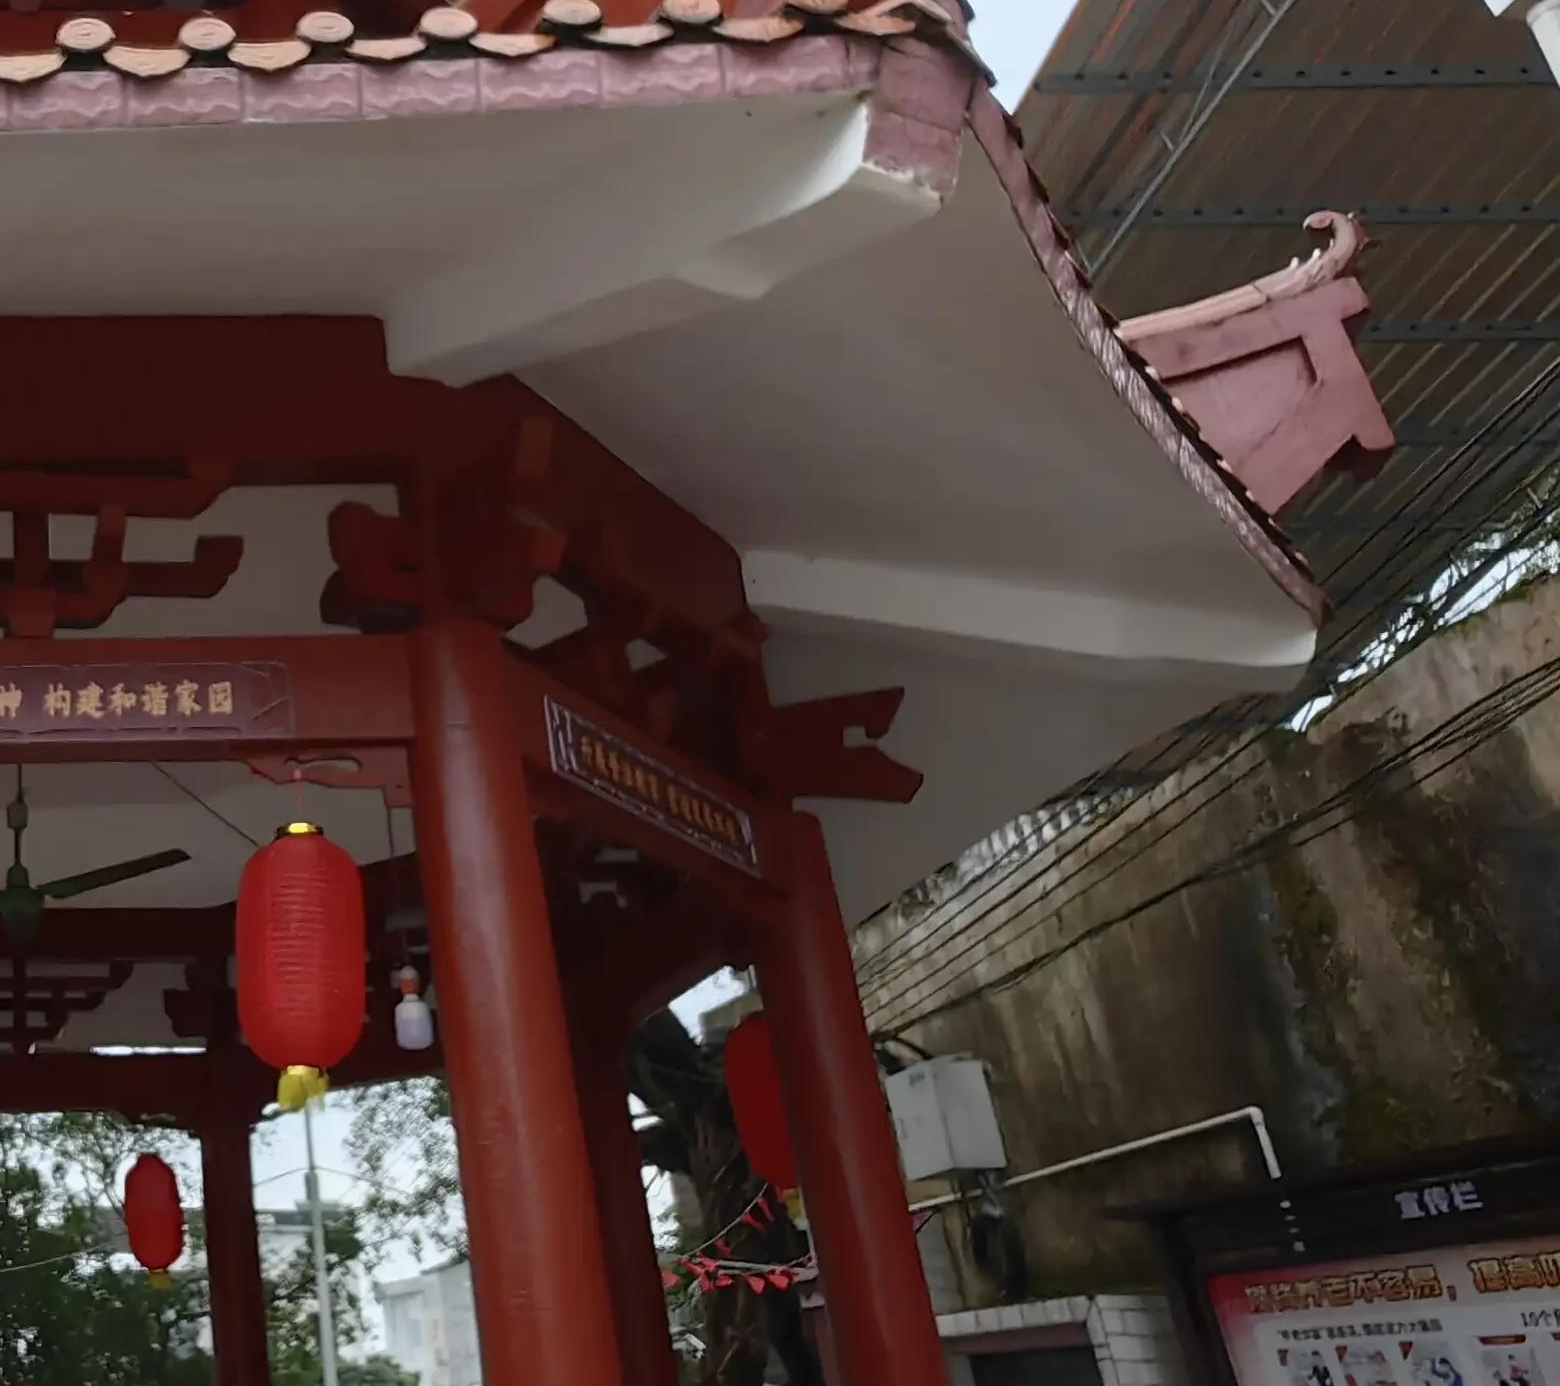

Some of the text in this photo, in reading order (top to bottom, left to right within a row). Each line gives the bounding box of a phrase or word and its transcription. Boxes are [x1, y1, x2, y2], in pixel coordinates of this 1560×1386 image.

[44, 680, 235, 719] 构建和谐家园
[1394, 1181, 1483, 1219] 宣传栏
